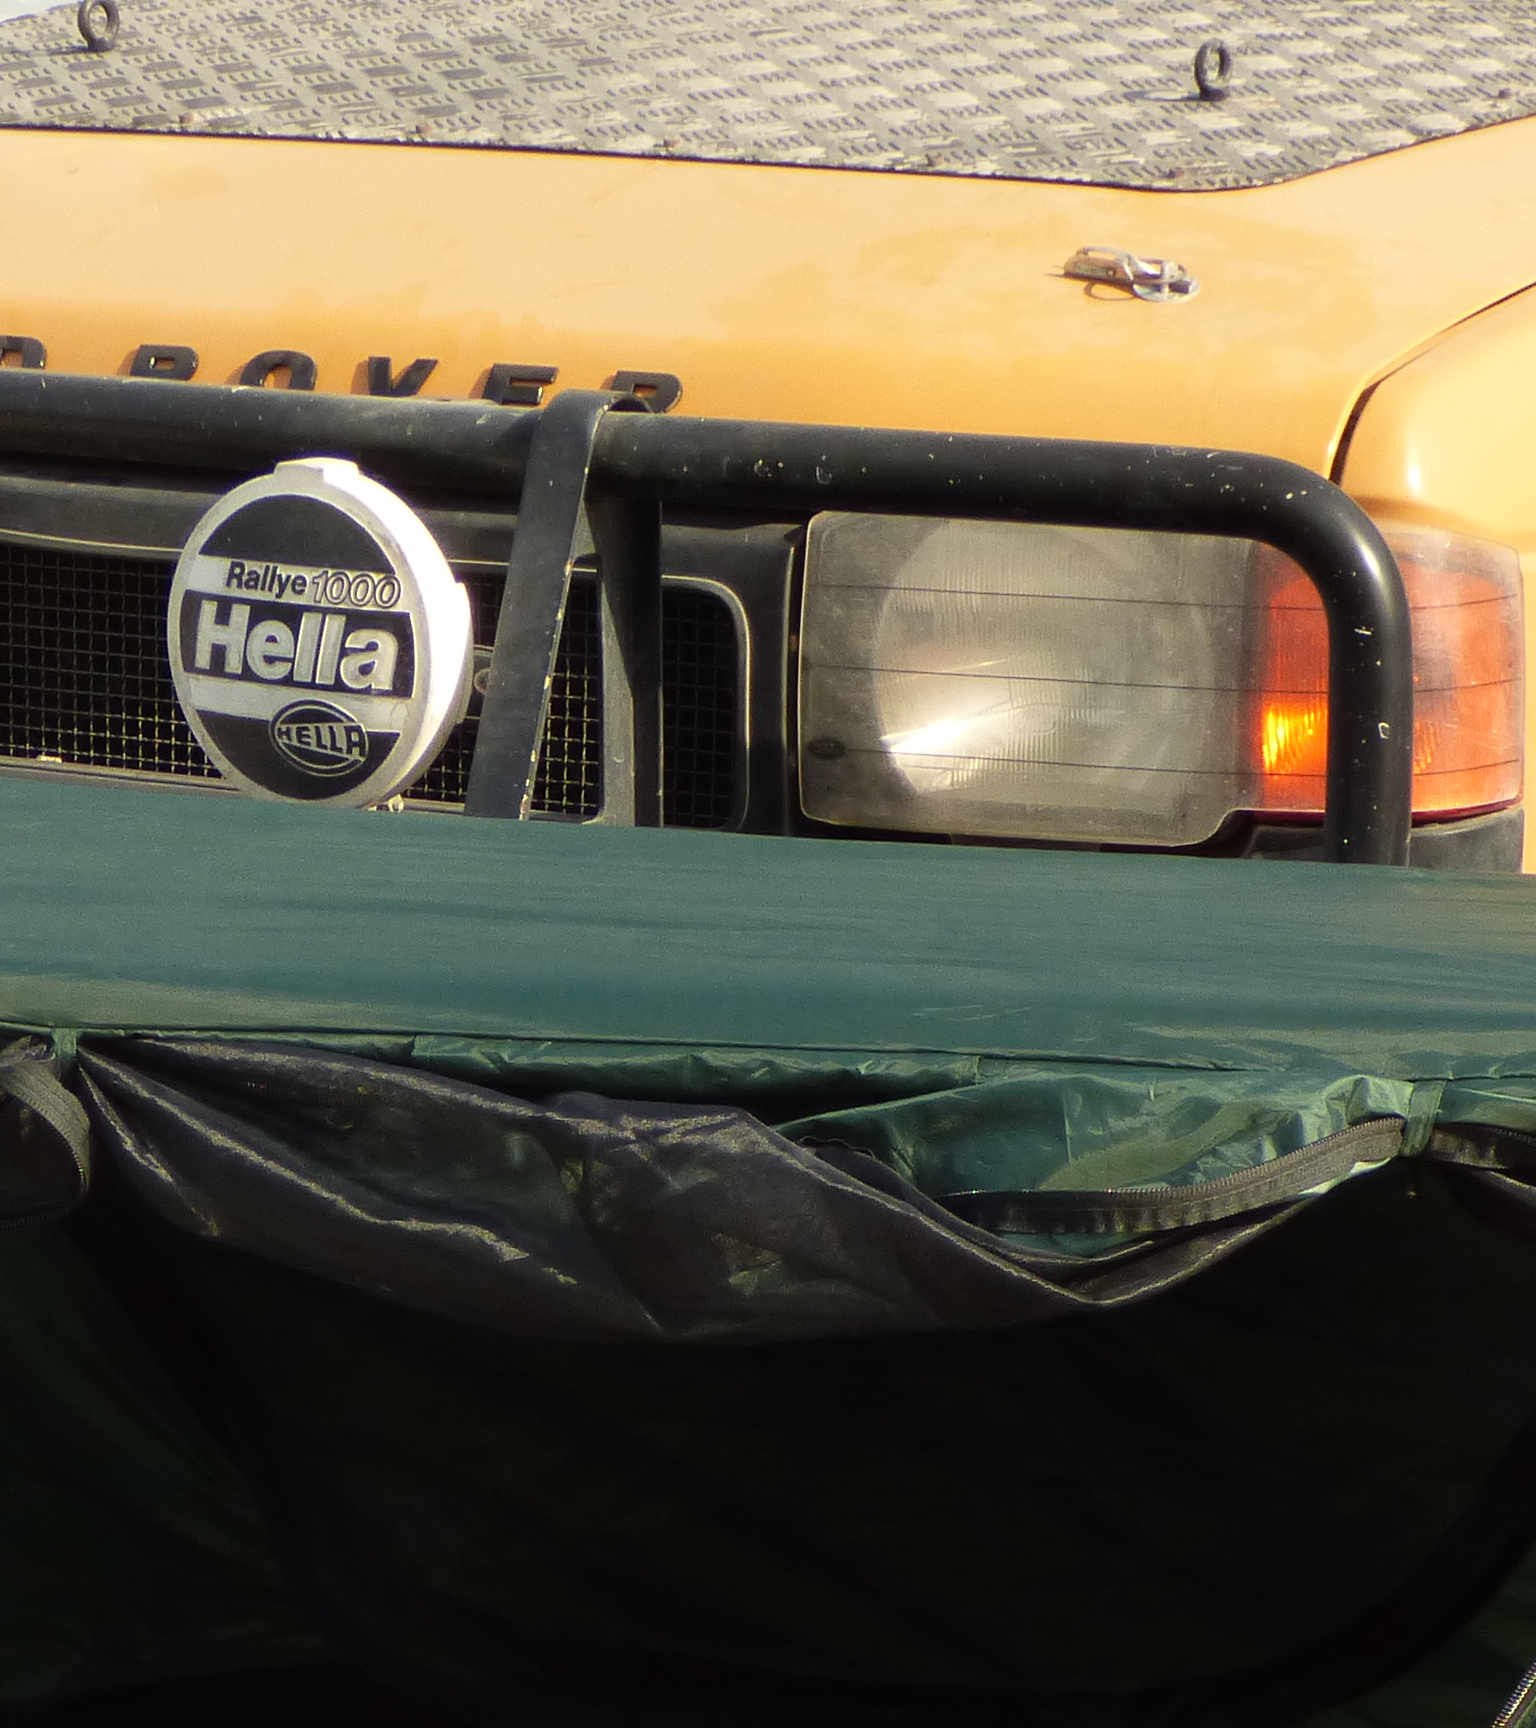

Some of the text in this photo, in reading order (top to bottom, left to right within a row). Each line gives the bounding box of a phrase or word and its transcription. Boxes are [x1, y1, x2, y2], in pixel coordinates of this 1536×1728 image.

[226, 561, 401, 609] Rallye 1000
[194, 600, 399, 691] Hella
[277, 723, 364, 758] HELLA
